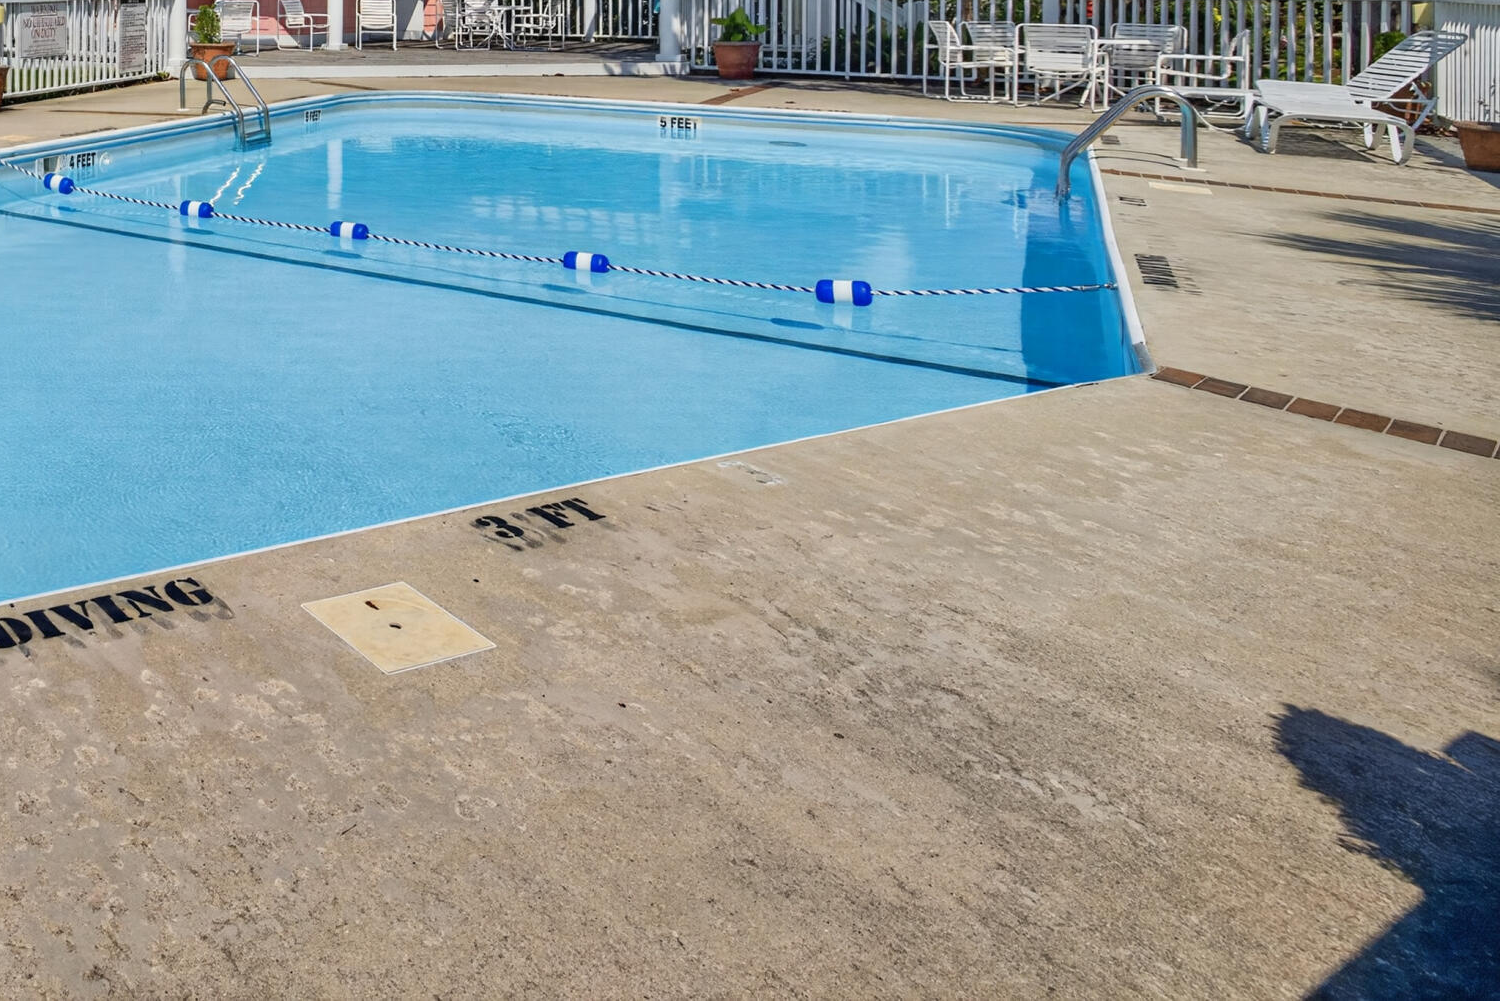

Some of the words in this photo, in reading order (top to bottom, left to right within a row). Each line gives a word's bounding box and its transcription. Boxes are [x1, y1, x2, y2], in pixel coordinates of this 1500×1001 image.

[660, 116, 667, 128] 5
[69, 155, 75, 169] 4
[77, 152, 97, 168] FEET
[475, 515, 525, 539] 3
[525, 498, 607, 529] FT
